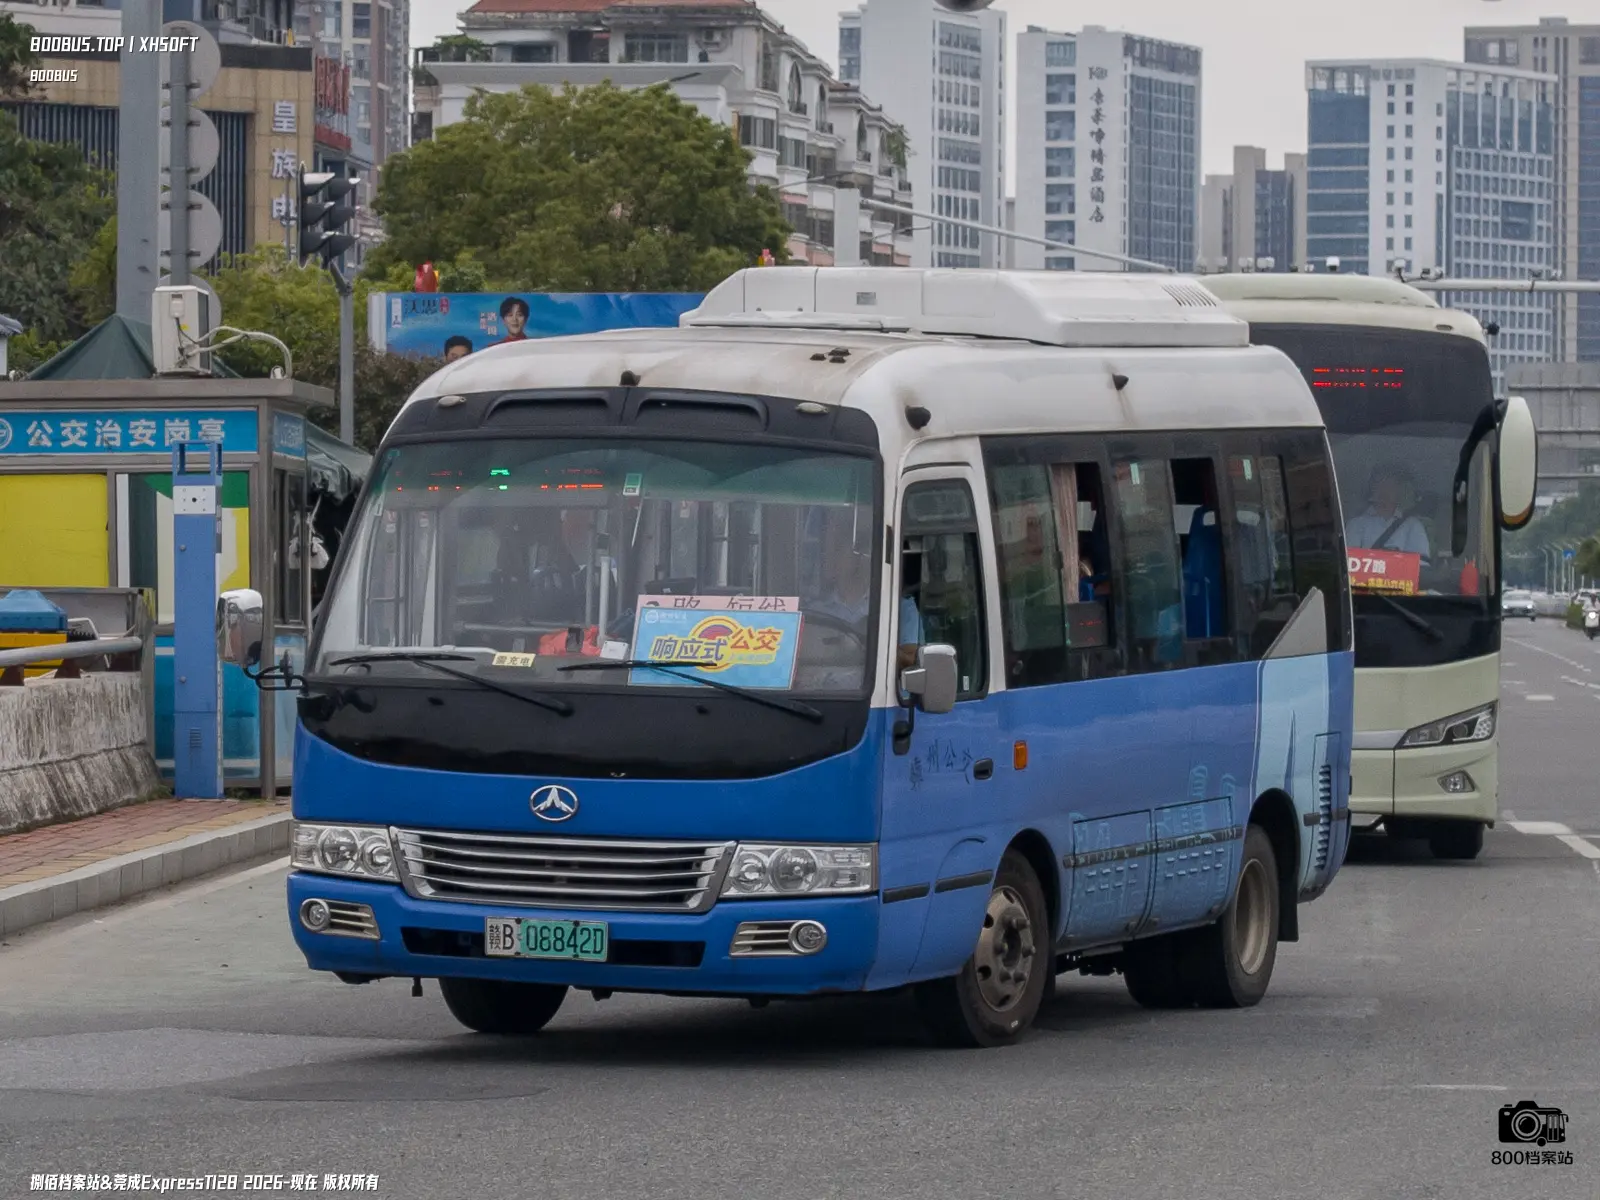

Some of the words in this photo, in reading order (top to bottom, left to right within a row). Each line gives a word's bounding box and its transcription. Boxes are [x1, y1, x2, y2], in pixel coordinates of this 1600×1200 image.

[26, 418, 225, 447] 公交治安岗亭
